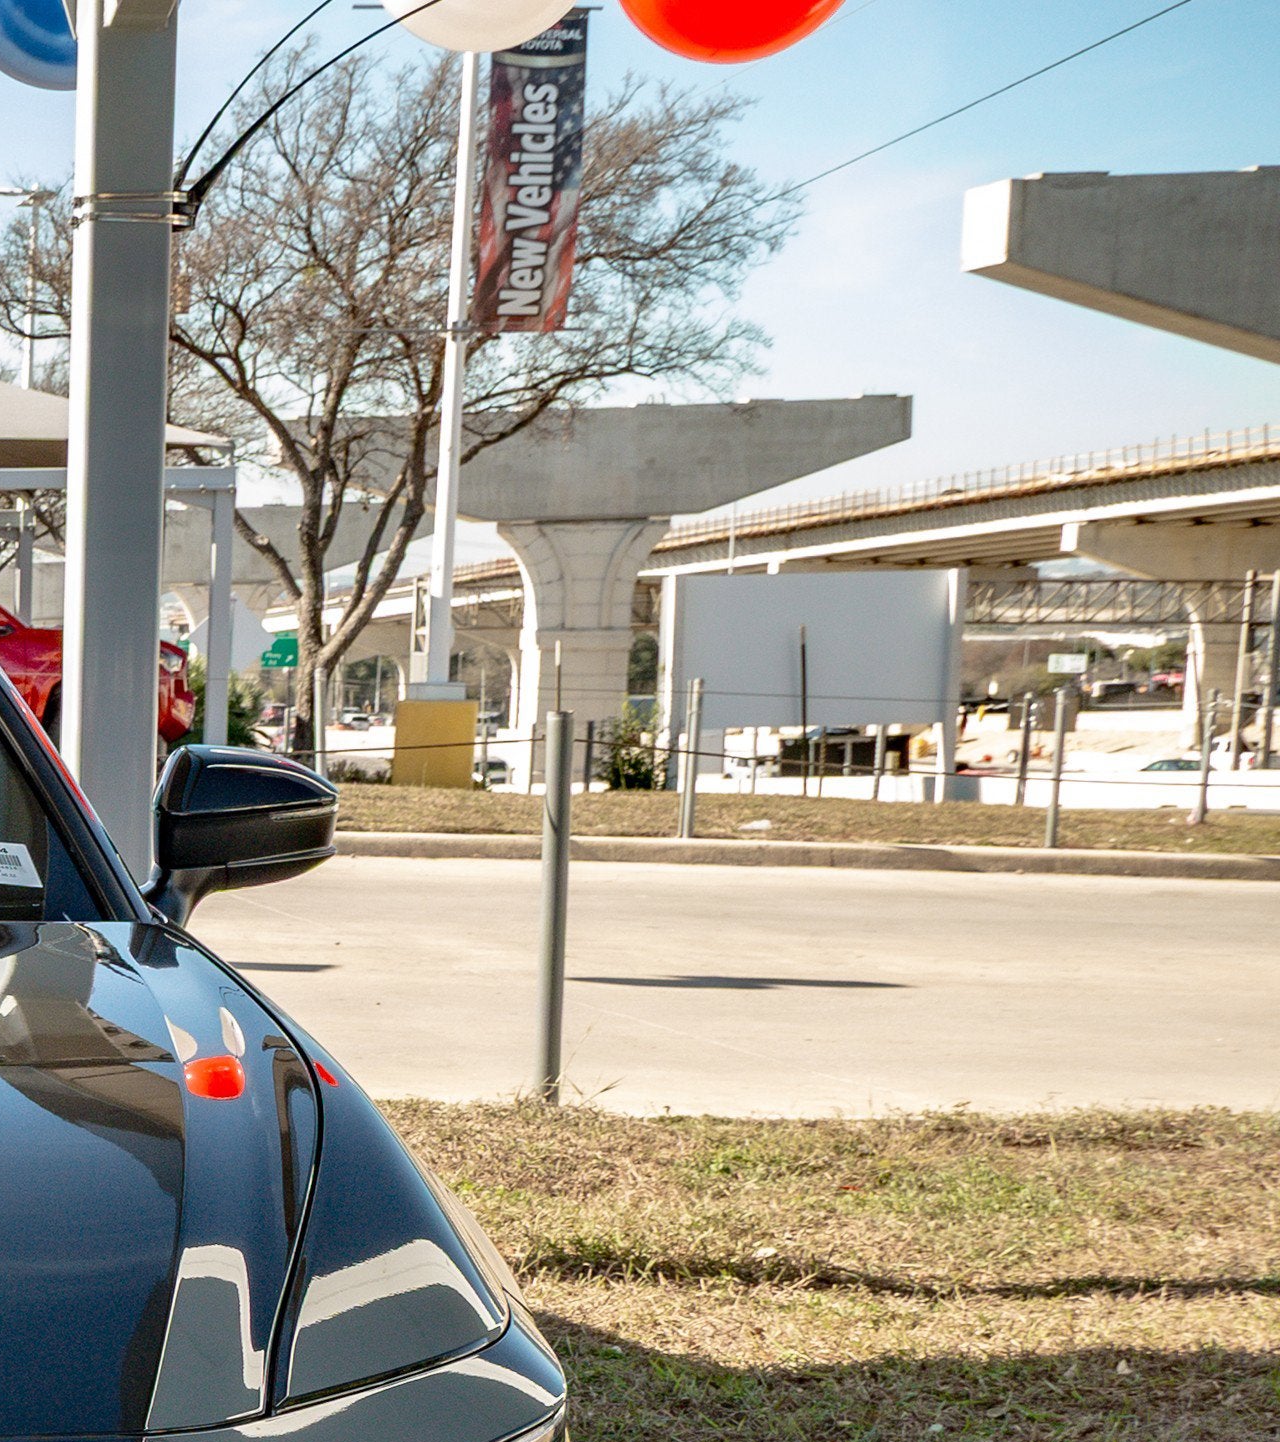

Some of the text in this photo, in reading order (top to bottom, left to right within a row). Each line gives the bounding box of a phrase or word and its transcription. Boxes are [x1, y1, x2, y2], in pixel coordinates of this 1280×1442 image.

[540, 29, 583, 41] VERSAL
[497, 82, 560, 316] New Vehicles
